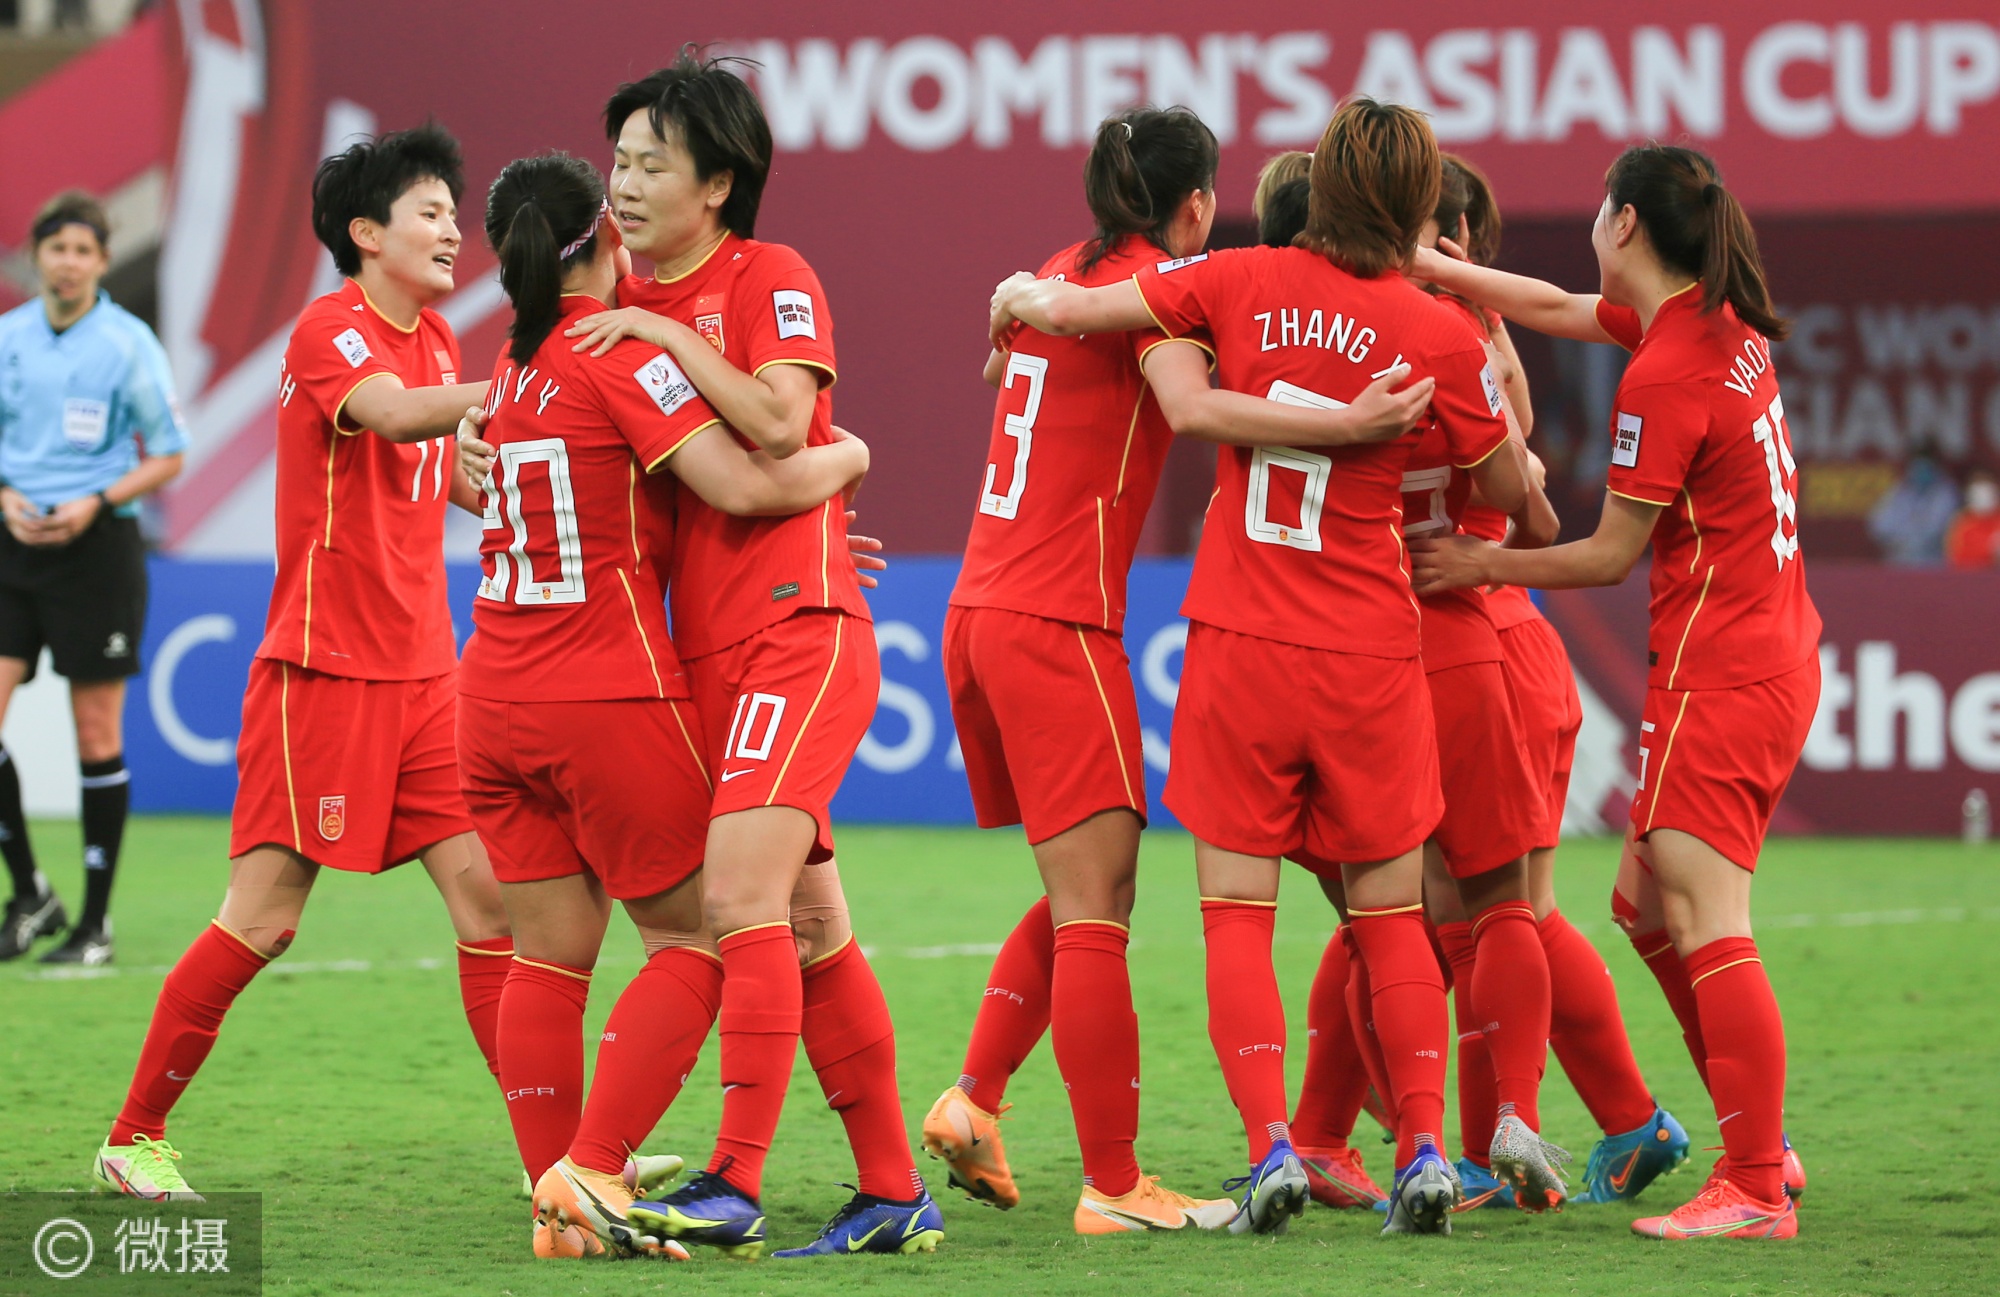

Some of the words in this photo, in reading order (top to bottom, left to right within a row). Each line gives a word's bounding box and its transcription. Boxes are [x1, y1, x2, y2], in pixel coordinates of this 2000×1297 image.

[750, 31, 1335, 149] WOMEN'S
[1356, 25, 1726, 144] ASIAN
[1741, 20, 2000, 139] CUP
[778, 304, 793, 314] OUR
[699, 319, 719, 329] CFA
[783, 314, 797, 323] FOR
[1253, 307, 1377, 364] ZHANG
[1724, 339, 1767, 399] YAO
[514, 366, 538, 403] Y
[537, 378, 560, 415] Y
[662, 393, 678, 408] ASIAN
[979, 352, 1048, 520] 3
[1619, 429, 1637, 441] GOAL
[1619, 440, 1632, 451] ALL
[411, 437, 445, 502] 11
[1752, 392, 1798, 573] 15
[1801, 641, 2000, 772] the
[724, 692, 787, 761] 10
[323, 800, 343, 809] CFA
[983, 987, 1024, 1005] CFA
[1239, 1044, 1282, 1056] CFA
[1415, 1050, 1438, 1059] 中国
[507, 1087, 554, 1101] CFA
